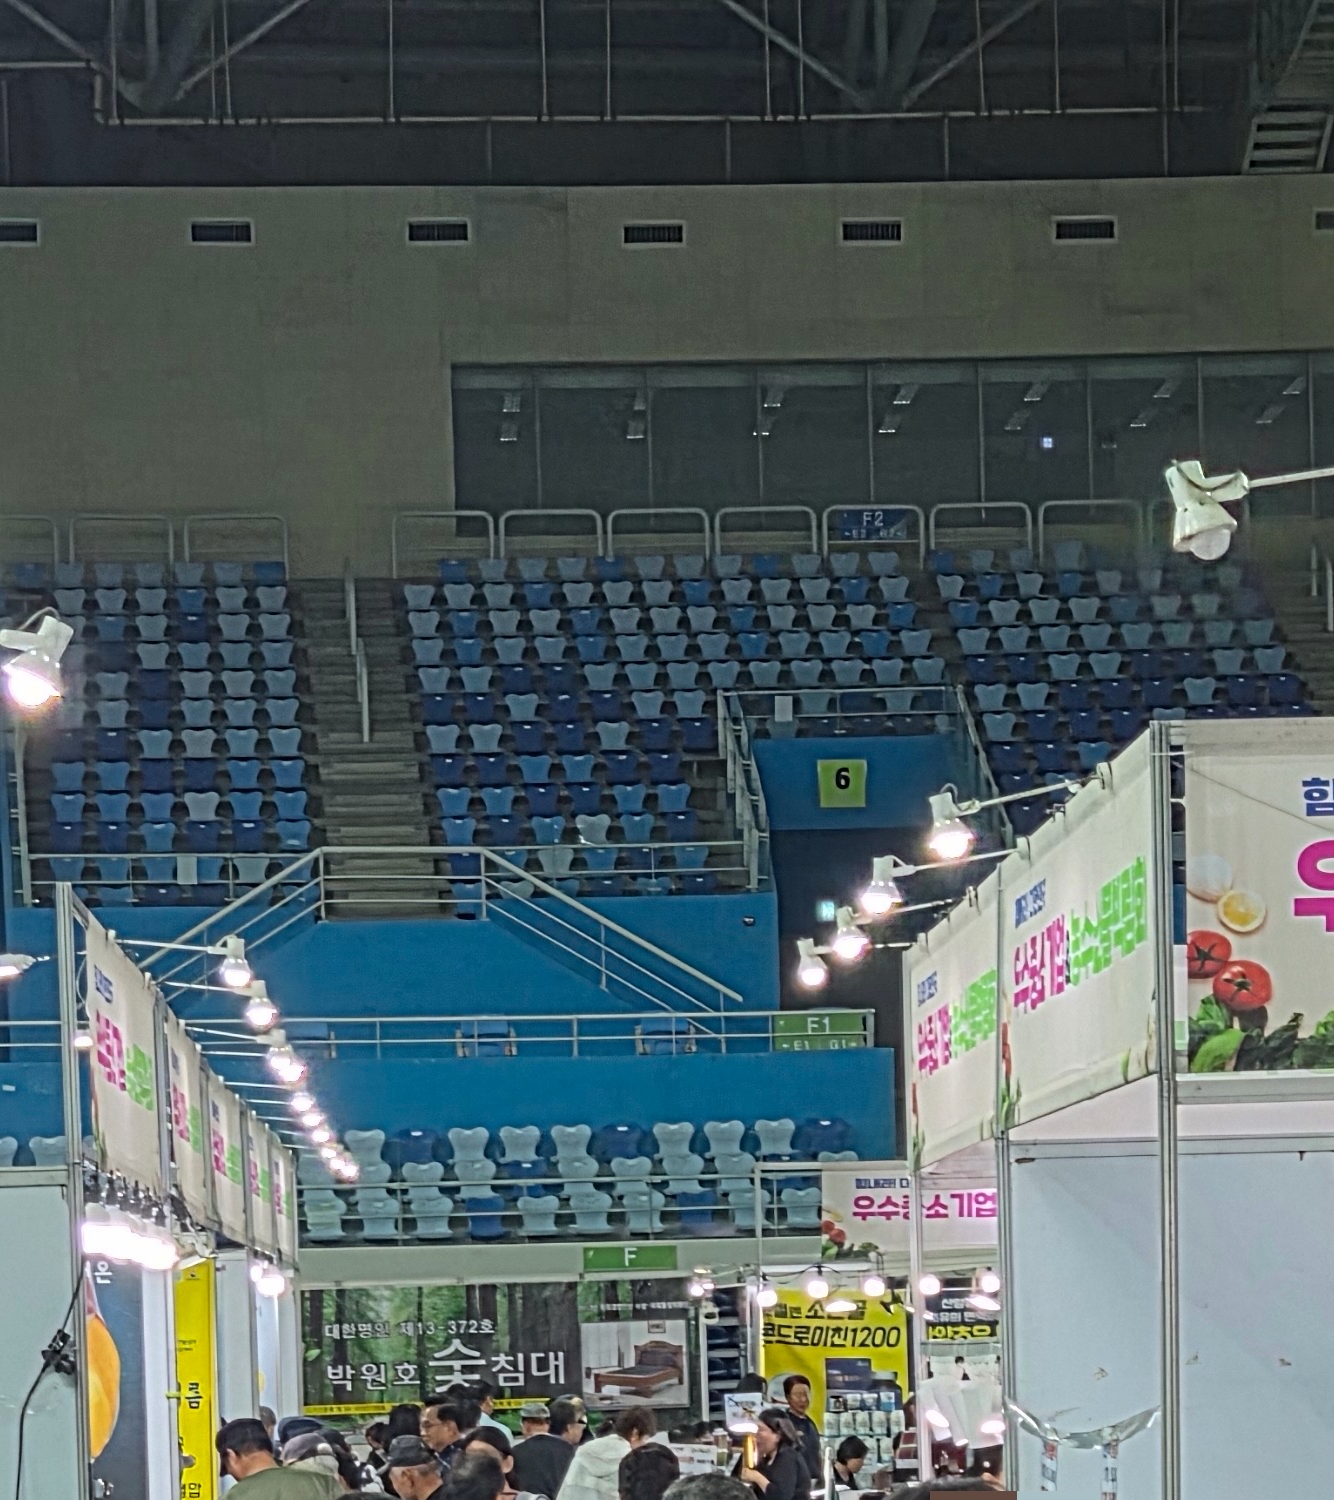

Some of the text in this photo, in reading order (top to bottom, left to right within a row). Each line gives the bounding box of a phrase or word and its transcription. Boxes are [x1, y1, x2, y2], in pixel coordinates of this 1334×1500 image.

[863, 511, 884, 527] F2
[835, 766, 851, 790] 6
[807, 1016, 830, 1034] F1
[624, 1247, 638, 1266] F
[324, 1318, 497, 1340] 대한명인 제13-372호
[326, 1363, 421, 1393] 박원호
